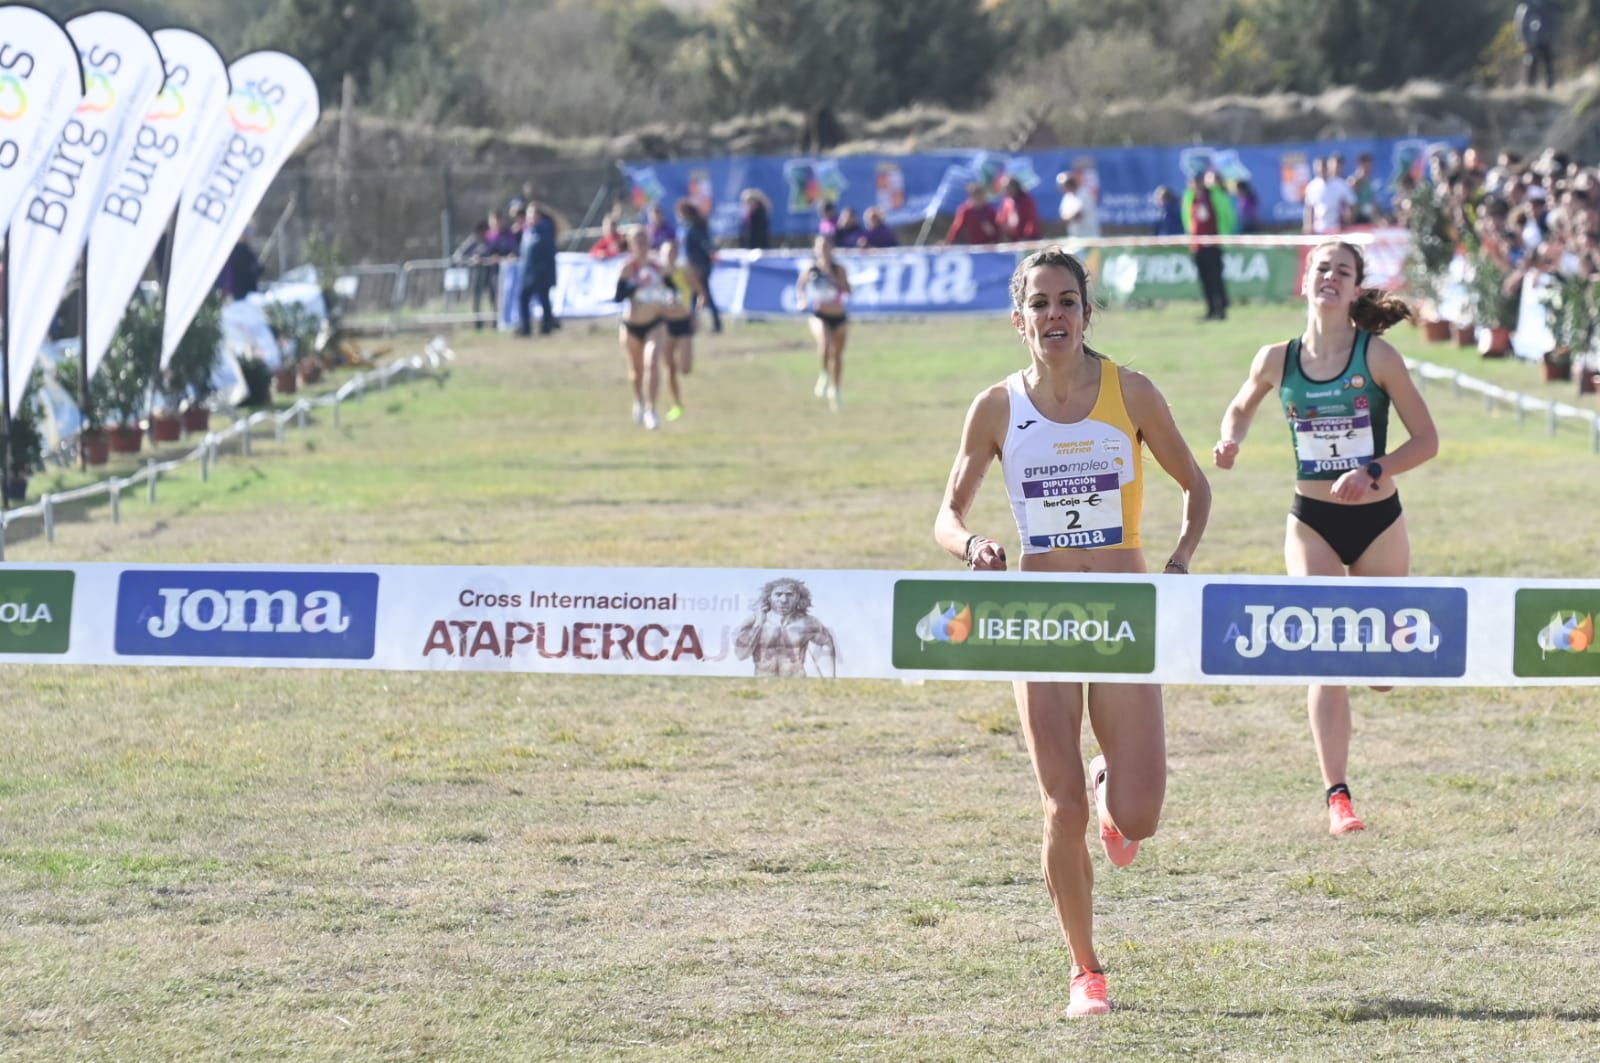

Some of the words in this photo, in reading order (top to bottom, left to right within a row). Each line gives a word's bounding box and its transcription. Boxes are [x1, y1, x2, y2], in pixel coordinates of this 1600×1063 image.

[1329, 443, 1341, 457] 1
[1024, 459, 1109, 479] grupompleo
[1042, 476, 1097, 489] DIPUTACIÓN
[1043, 485, 1097, 497] BURGOS
[1065, 510, 1082, 530] 2
[458, 588, 522, 608] Cross
[530, 590, 678, 611] Internacional
[0, 602, 54, 624] OLA
[147, 587, 350, 639] Joma
[421, 619, 705, 662] ATAPUERCA
[978, 616, 1136, 643] IBERDROLA
[1235, 604, 1440, 659] Joma
